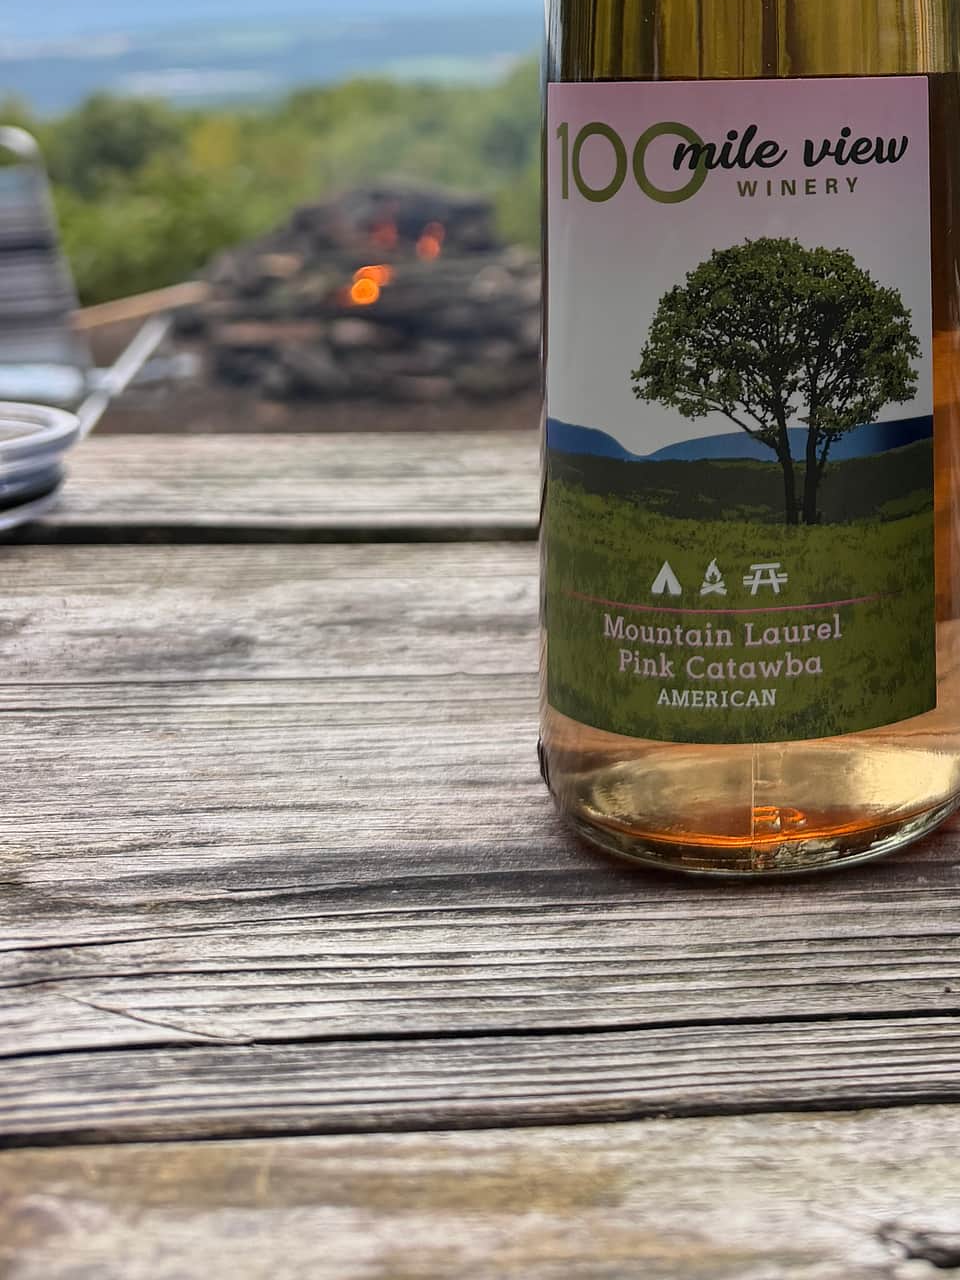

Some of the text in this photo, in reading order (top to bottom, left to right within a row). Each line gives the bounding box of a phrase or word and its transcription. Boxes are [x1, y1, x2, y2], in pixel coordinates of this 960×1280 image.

[556, 122, 909, 204] 100 mile view
[737, 177, 859, 197] WINERY
[603, 614, 843, 647] Mountain Laurel
[618, 649, 823, 680] Pink Catawba
[656, 688, 777, 707] AMERICAN
